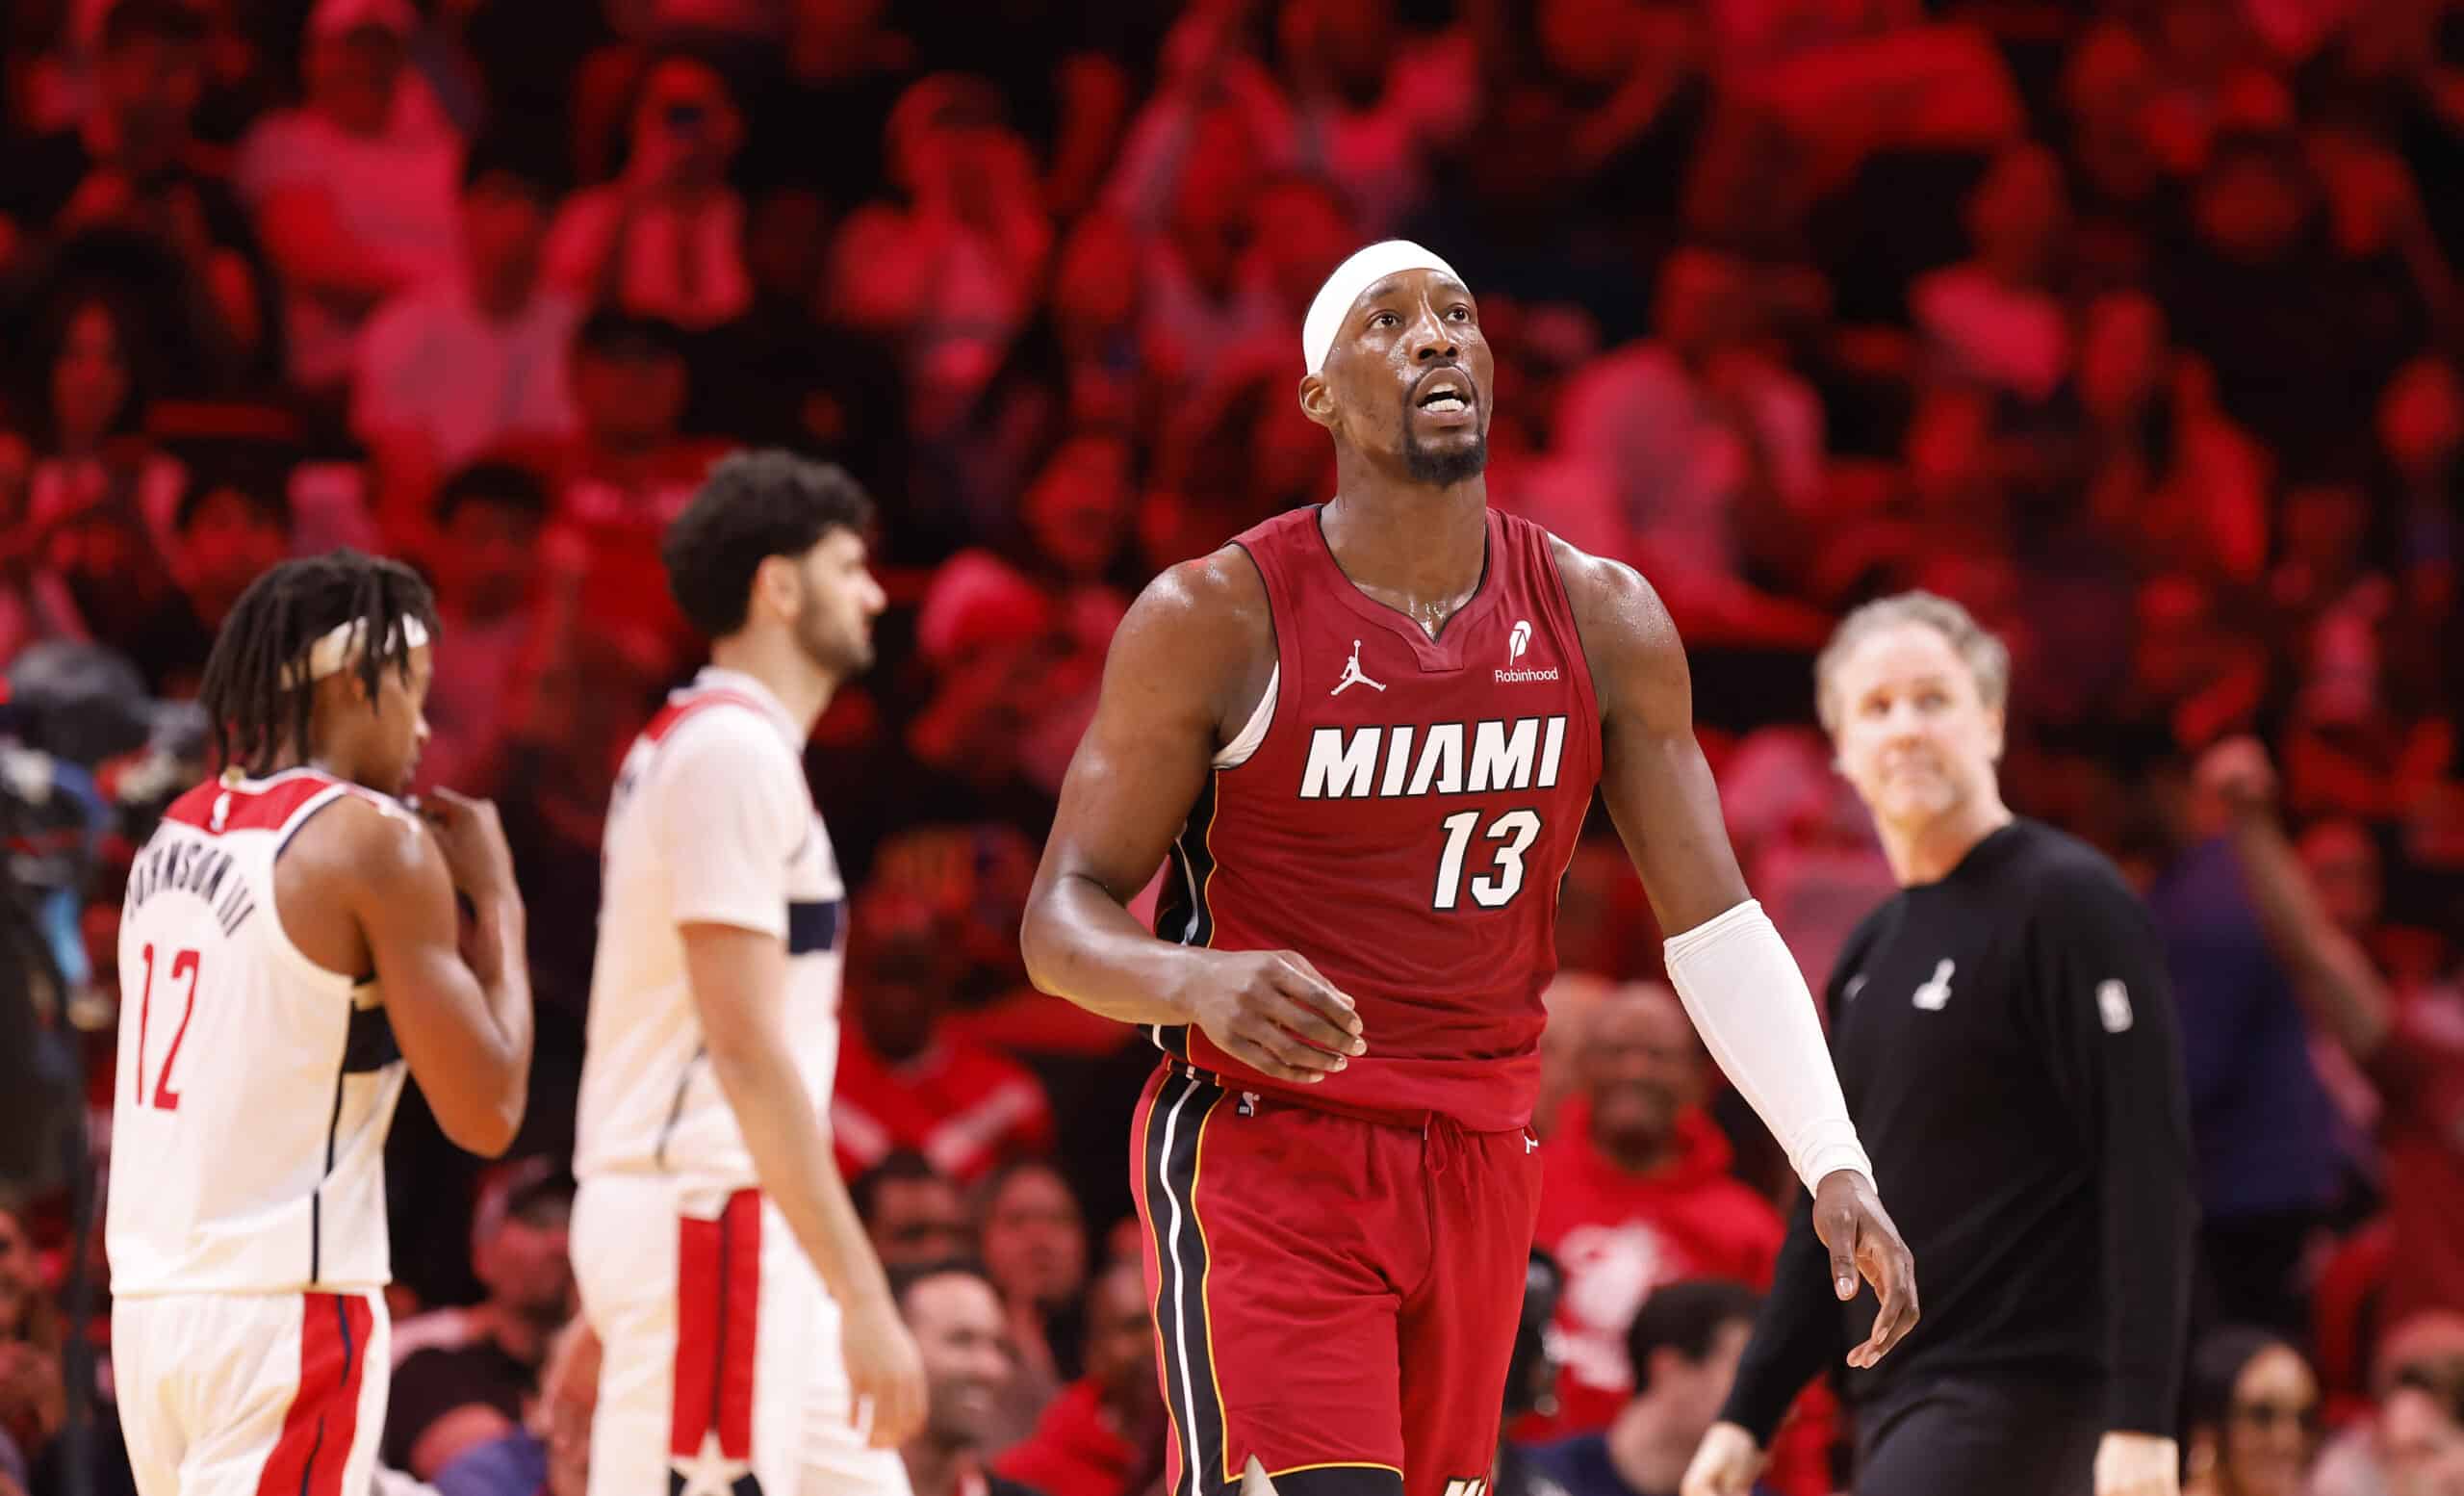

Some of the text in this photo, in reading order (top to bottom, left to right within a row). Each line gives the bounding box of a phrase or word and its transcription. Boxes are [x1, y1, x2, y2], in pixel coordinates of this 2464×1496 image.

[1494, 666, 1559, 684] Robinhood
[1298, 715, 1567, 799] MIAMI
[1432, 808, 1542, 911] 13
[217, 873, 255, 938] III
[137, 942, 200, 1110] 12
